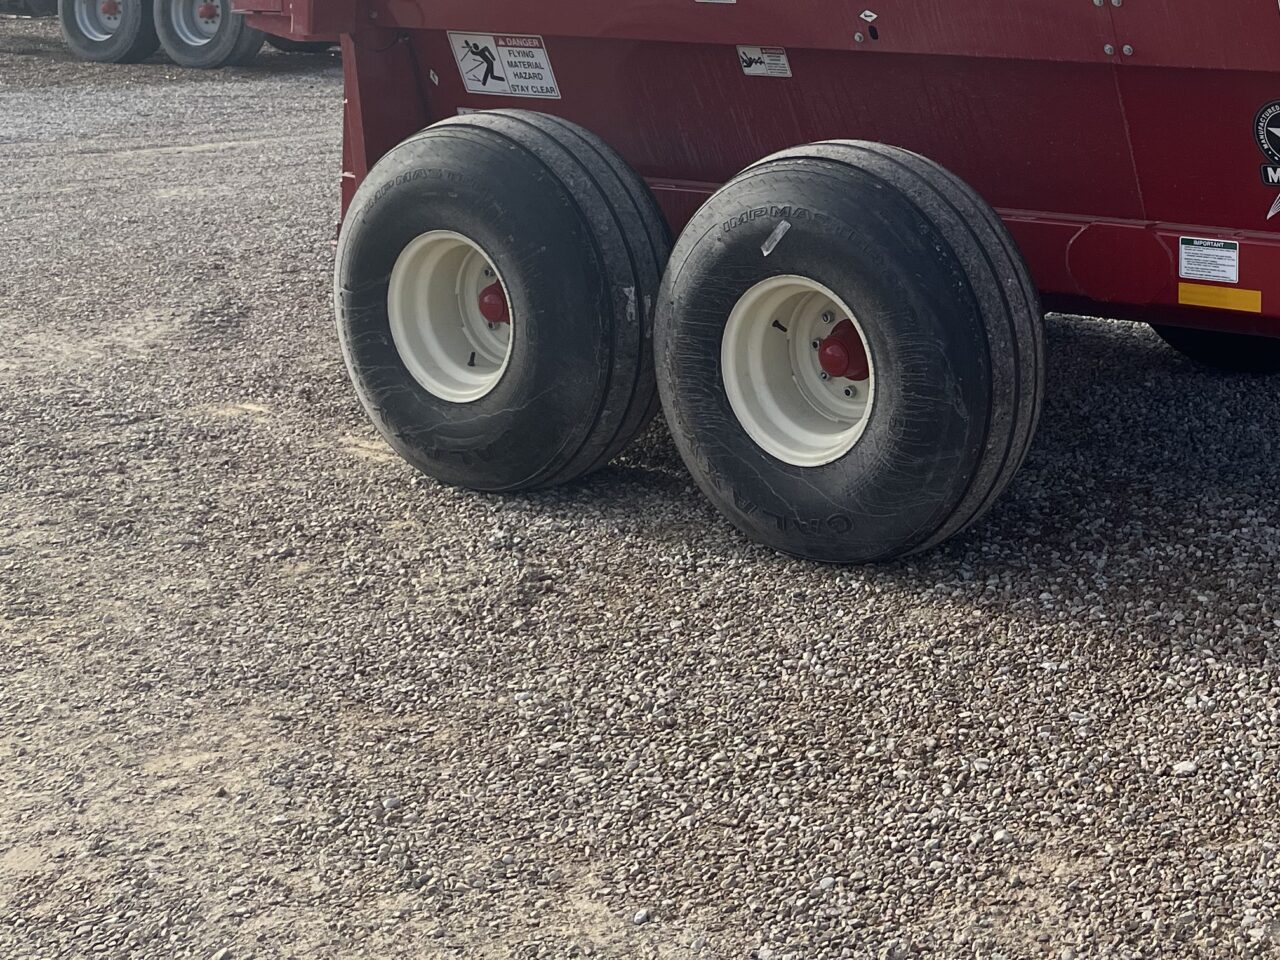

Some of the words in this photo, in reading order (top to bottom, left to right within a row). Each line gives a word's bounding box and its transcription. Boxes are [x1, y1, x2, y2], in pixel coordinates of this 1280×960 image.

[506, 37, 540, 47] DANGER
[508, 49, 535, 58] FLYING
[507, 60, 544, 70] MATERIAL
[513, 71, 544, 81] HAZARD
[511, 84, 530, 93] STAY
[531, 85, 556, 94] CLEAR
[1257, 104, 1280, 150] MANUFACTURED
[1193, 240, 1225, 248] IMPORTANT
